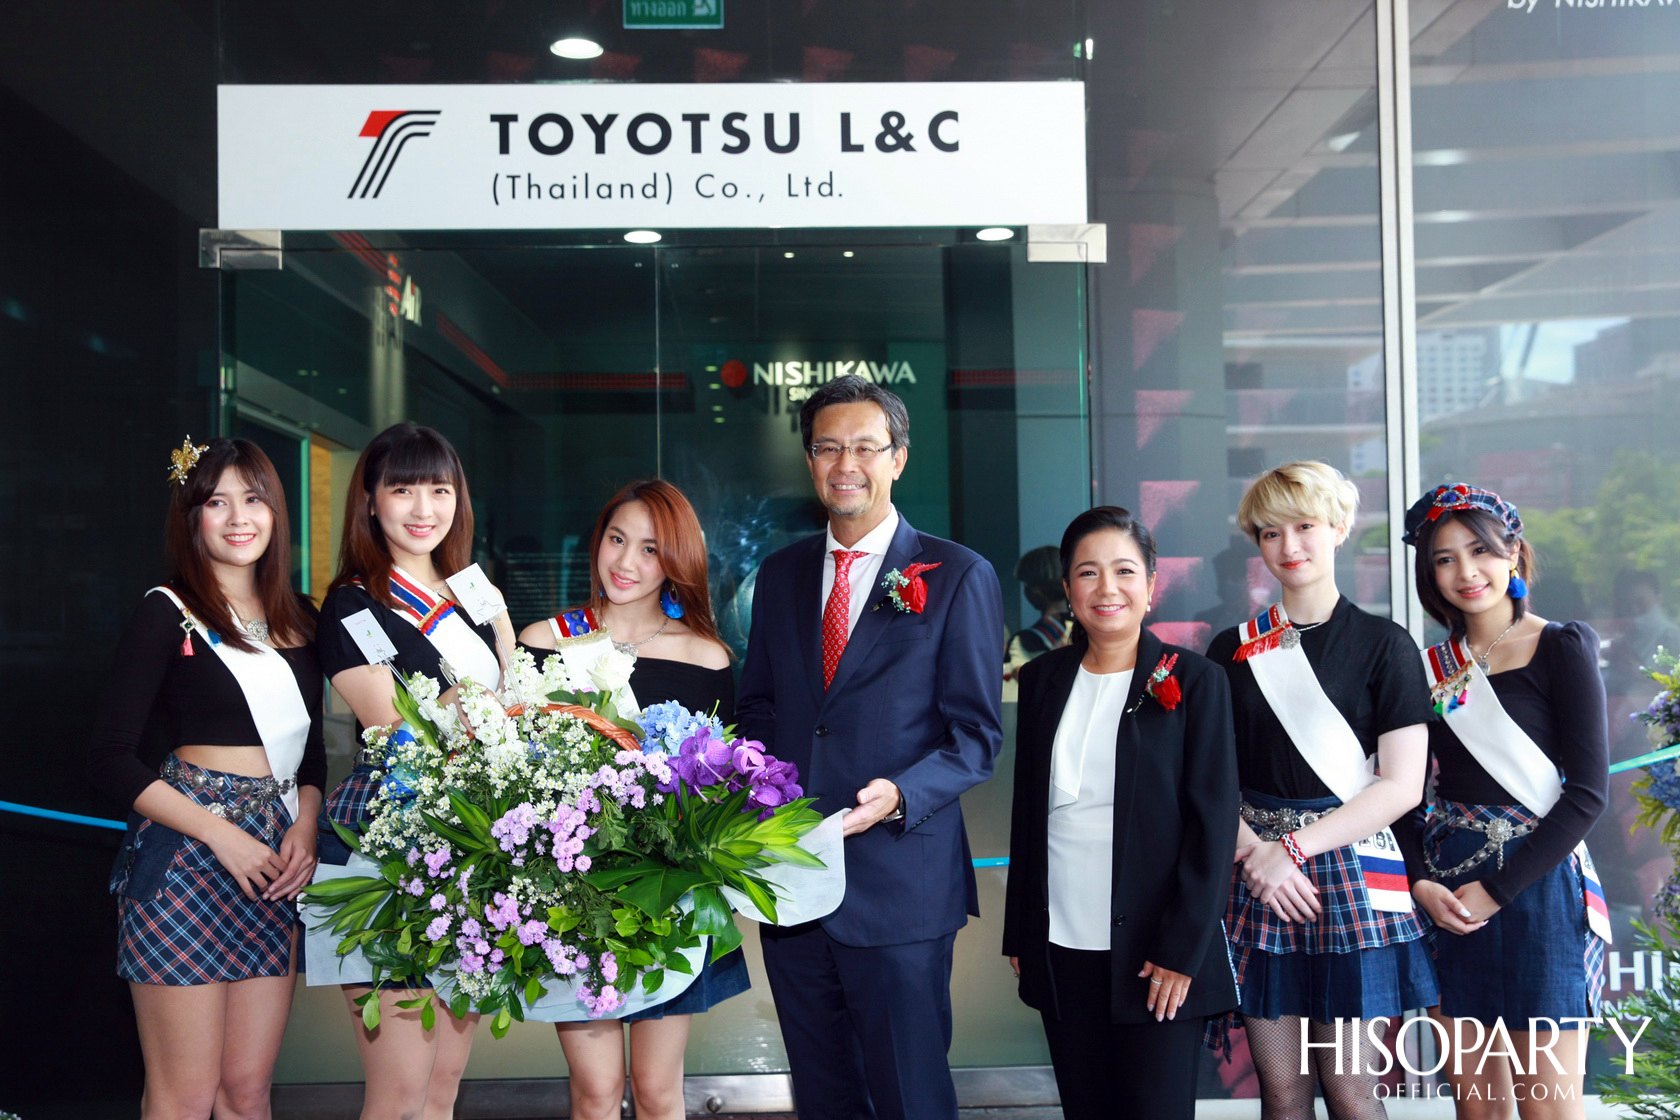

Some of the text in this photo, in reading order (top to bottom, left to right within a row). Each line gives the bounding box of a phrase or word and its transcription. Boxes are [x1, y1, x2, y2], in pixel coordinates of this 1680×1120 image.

[489, 110, 960, 156] TOYOTSU L&C
[492, 171, 844, 206] (Thailand) Co., Ltd.
[753, 360, 917, 386] NISHIKAWA
